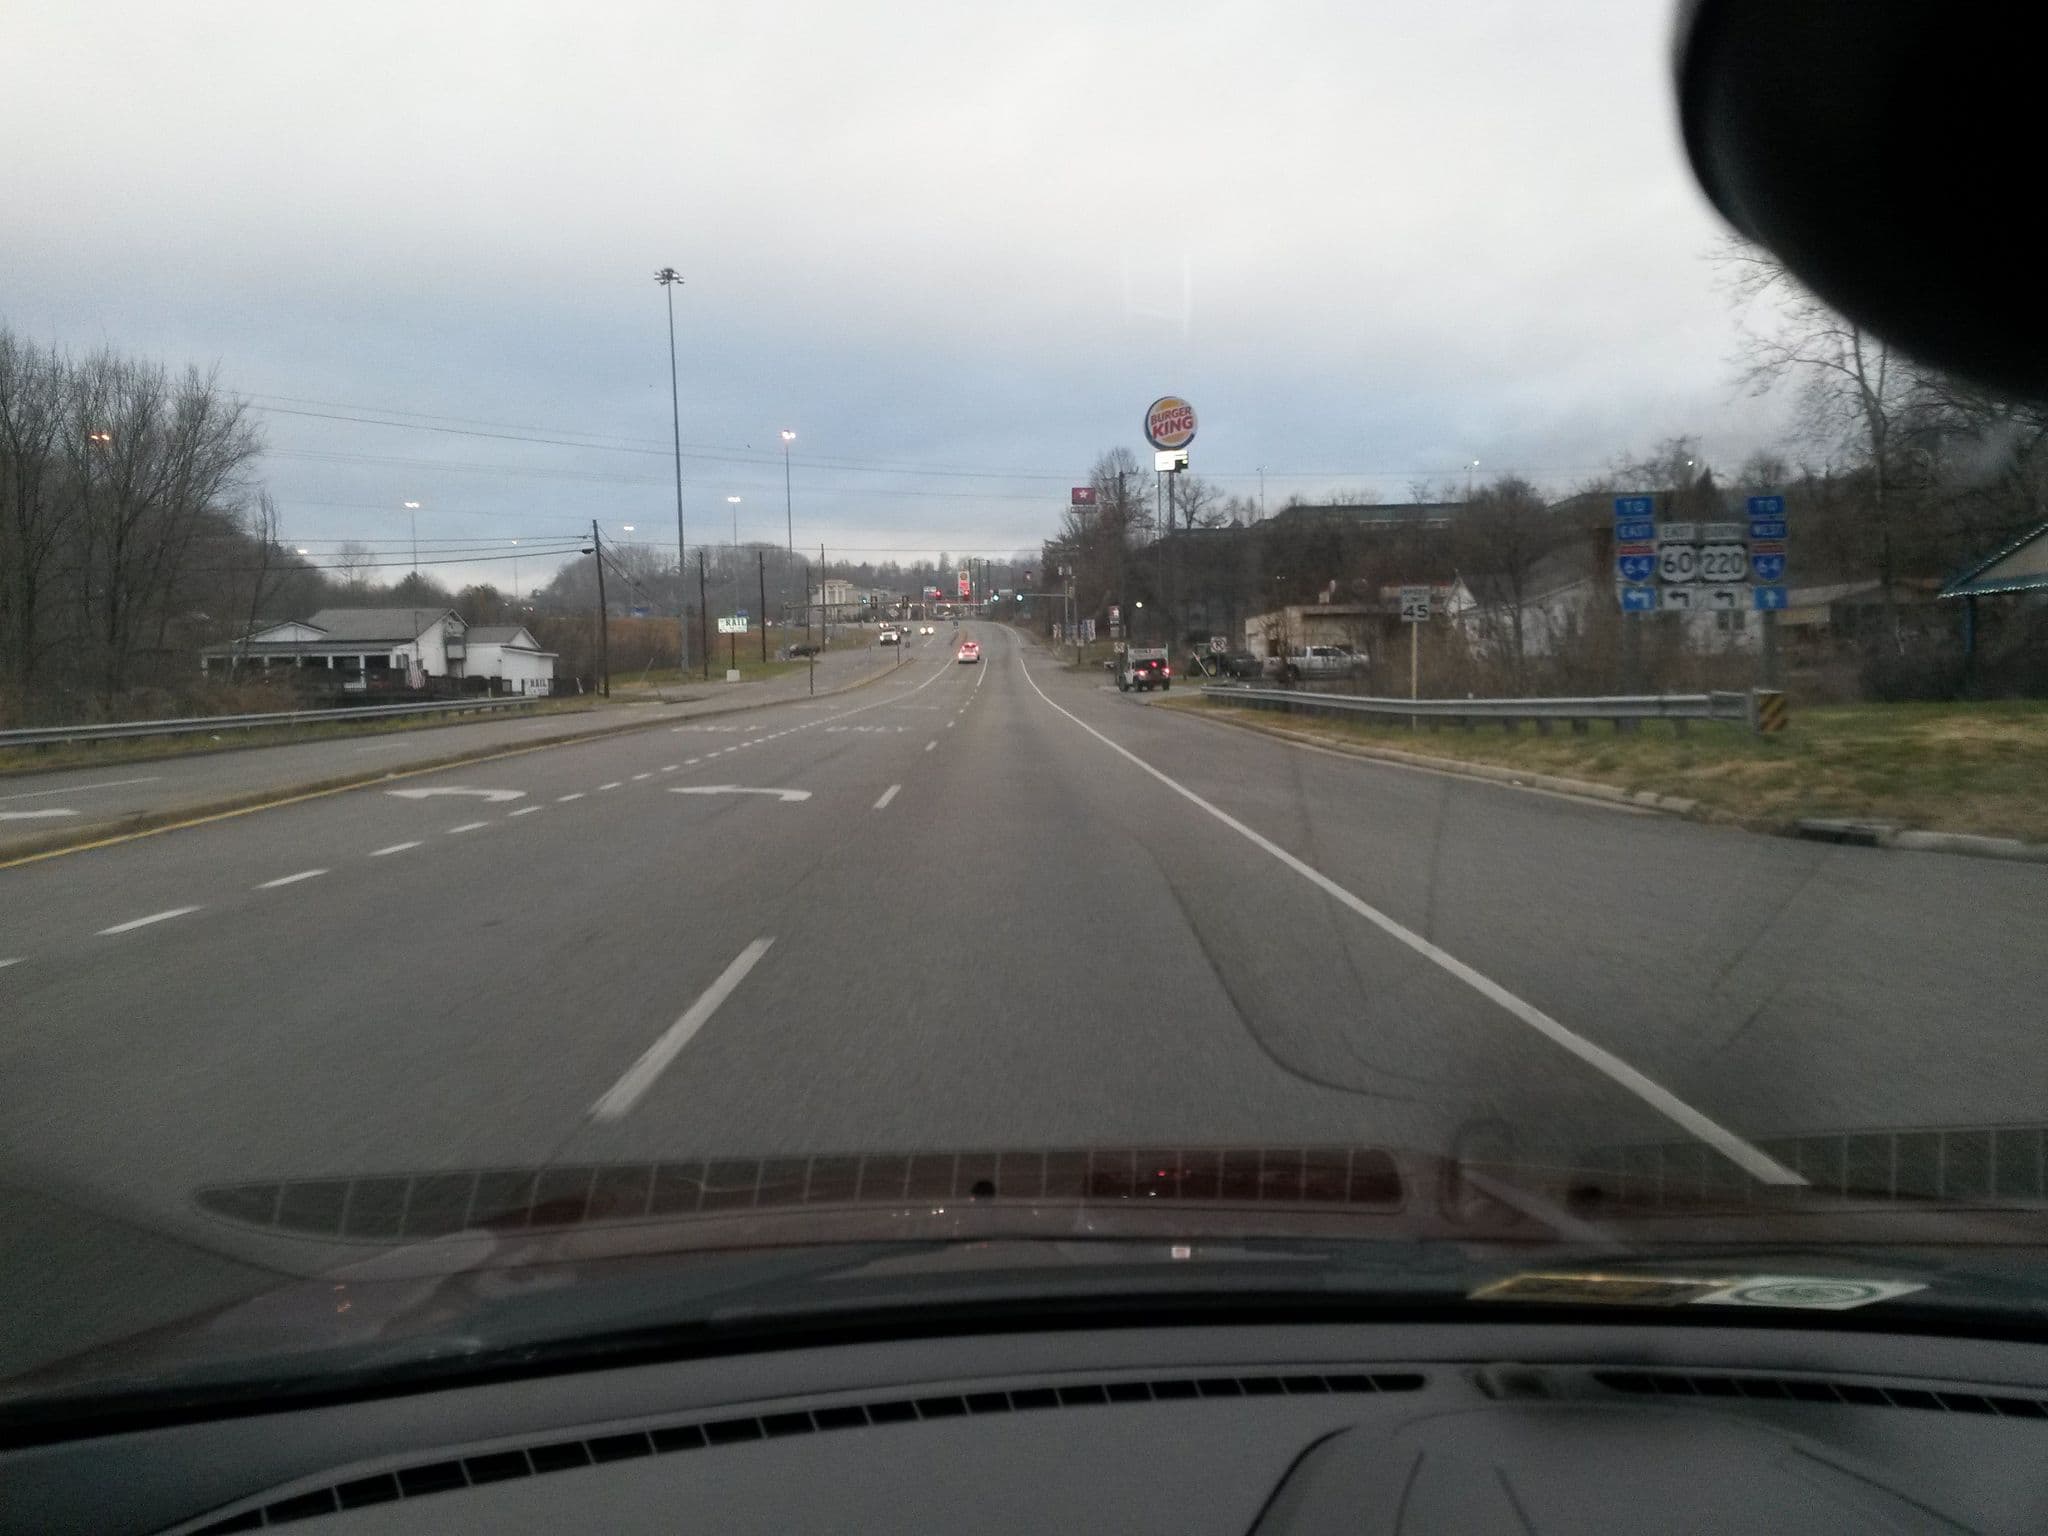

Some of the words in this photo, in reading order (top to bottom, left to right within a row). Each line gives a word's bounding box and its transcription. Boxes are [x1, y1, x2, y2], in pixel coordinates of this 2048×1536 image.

[1151, 406, 1192, 426] BURGER
[1152, 416, 1194, 440] KING
[1624, 501, 1646, 513] TO
[1625, 559, 1650, 575] 64
[1663, 552, 1693, 574] 60
[1705, 552, 1743, 574] 220
[1756, 558, 1781, 575] 64
[1403, 605, 1428, 618] 45
